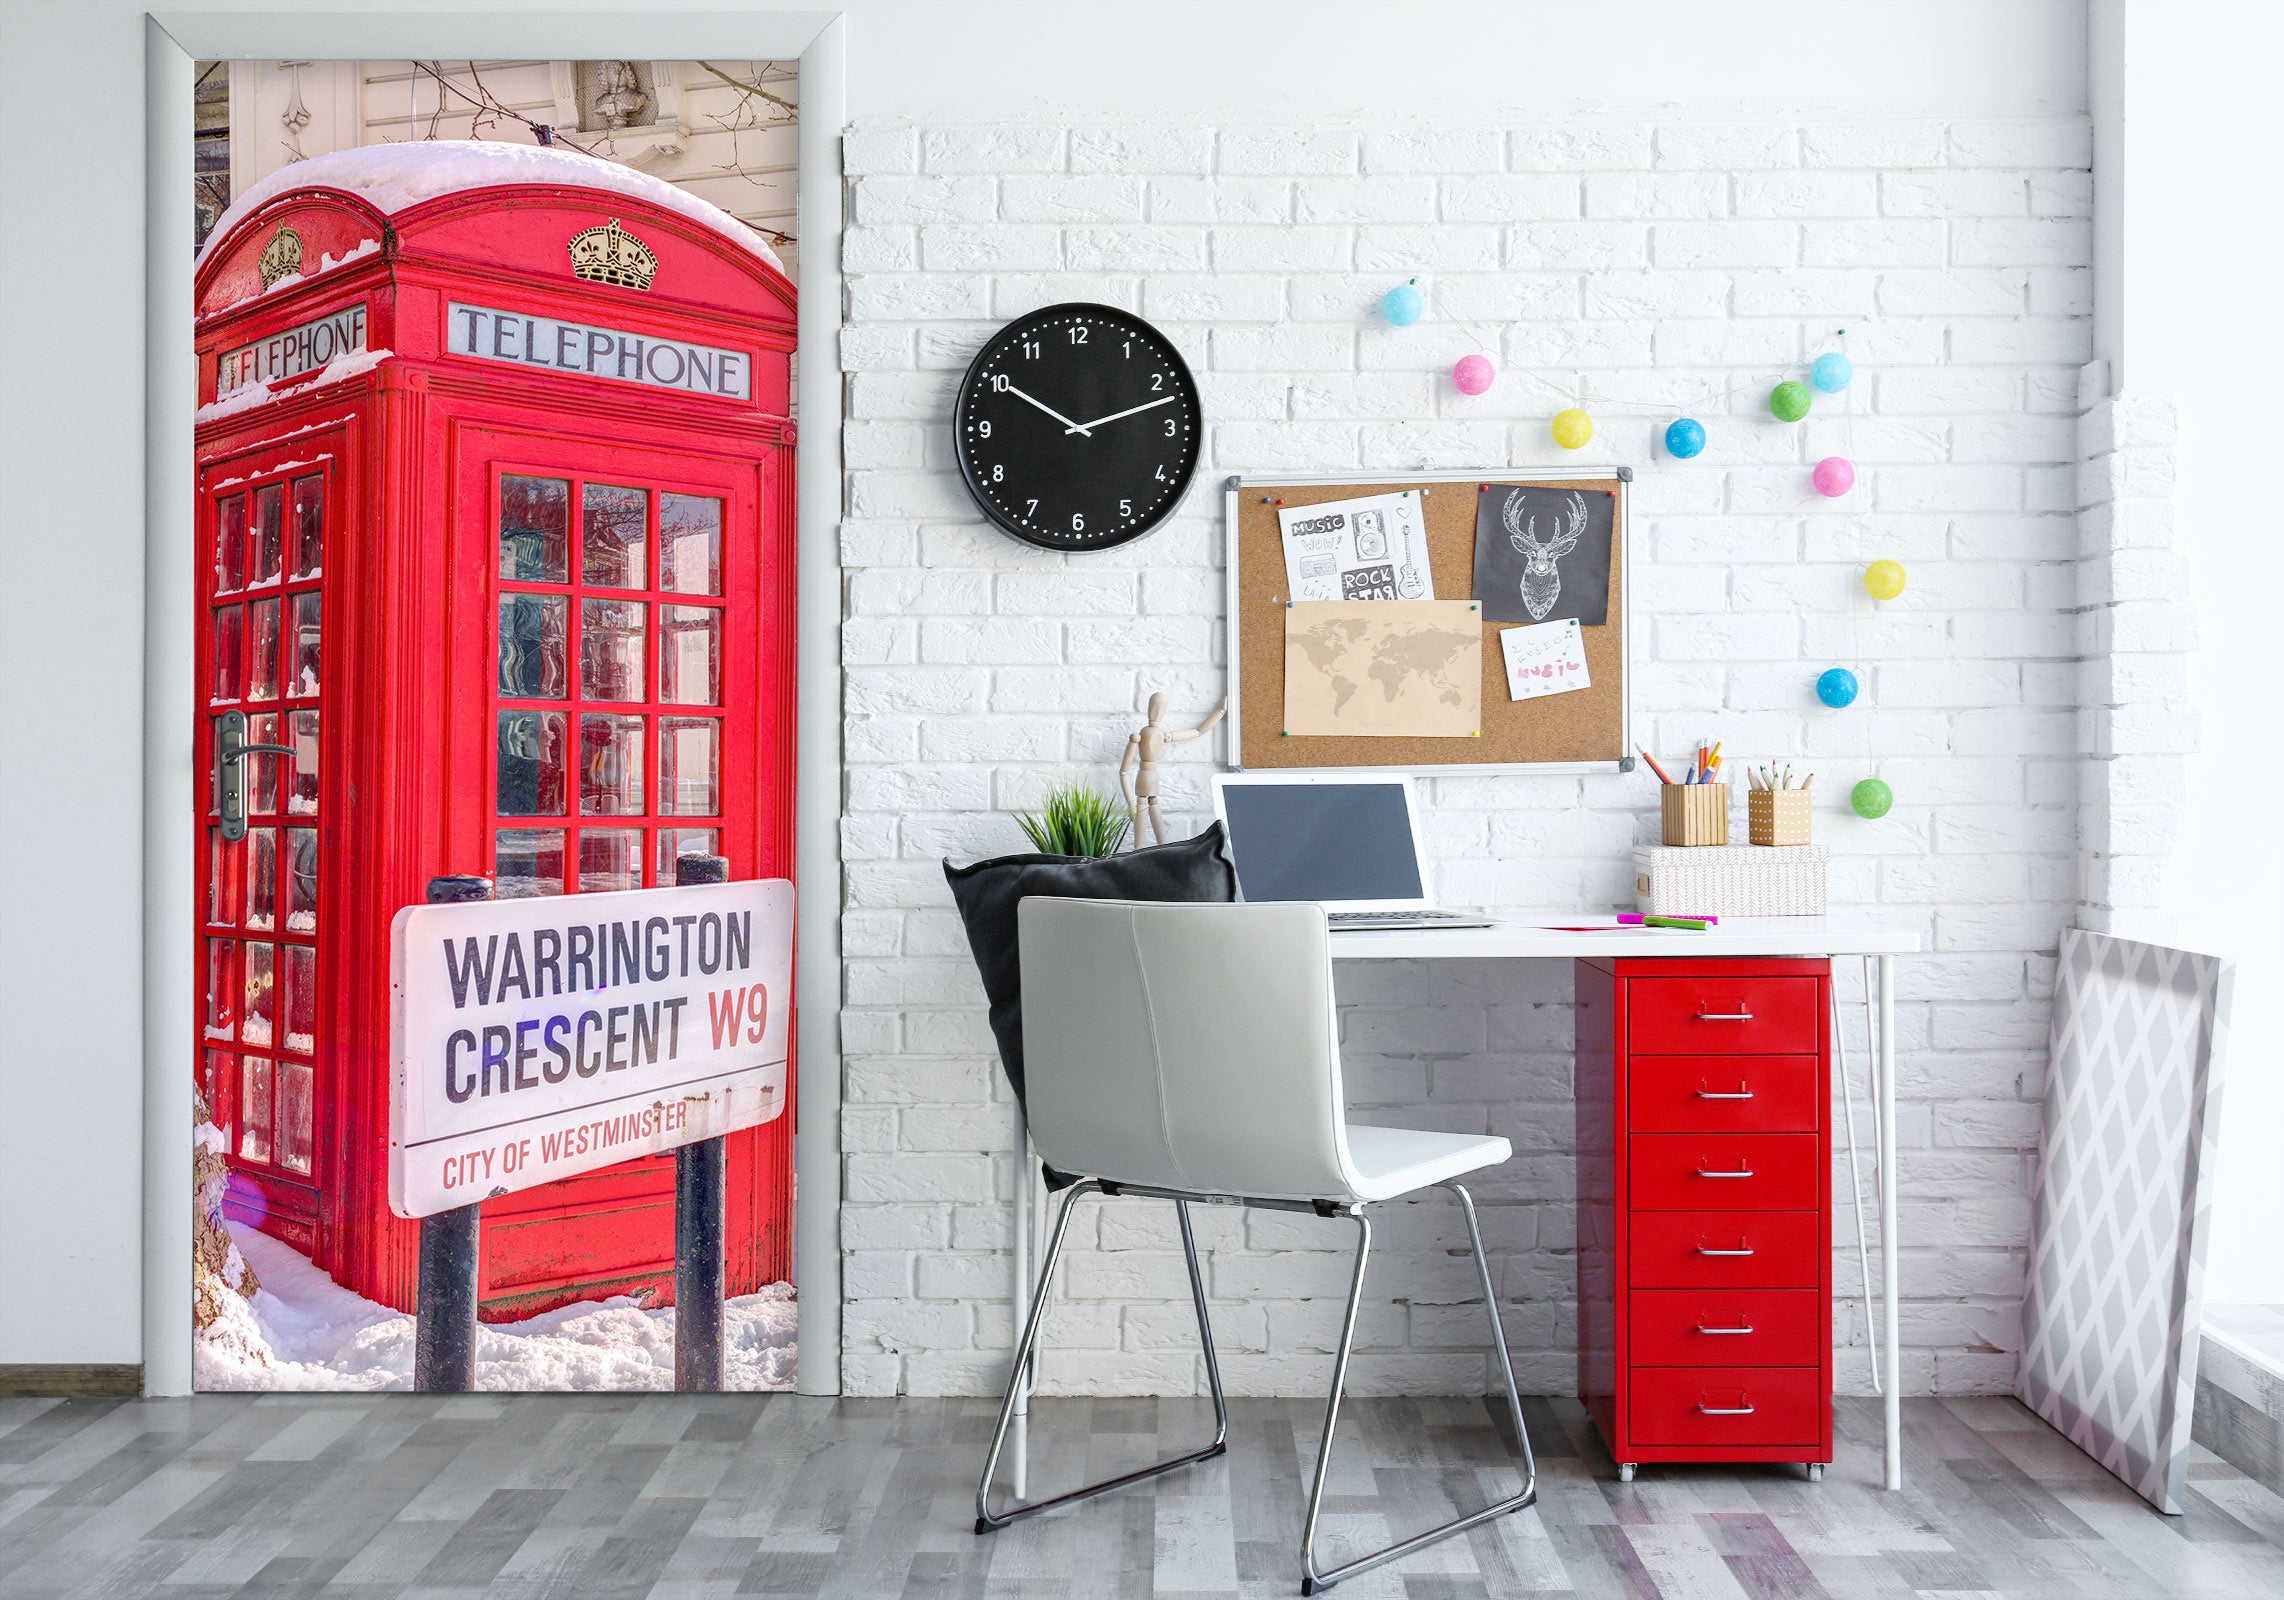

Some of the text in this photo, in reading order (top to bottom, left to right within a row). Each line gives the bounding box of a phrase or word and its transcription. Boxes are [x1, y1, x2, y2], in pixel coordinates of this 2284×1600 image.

[1068, 327, 1088, 344] 12
[458, 308, 740, 396] TELEPHONE
[1023, 343, 1040, 359] 11
[1123, 343, 1129, 359] 1
[990, 375, 1009, 392] 10
[1151, 374, 1163, 391] 2
[979, 421, 991, 438] 9
[1165, 420, 1176, 437] 3
[993, 465, 1003, 482] 8
[1155, 465, 1166, 481] 4
[1027, 499, 1038, 516] 7
[1120, 500, 1131, 516] 5
[1073, 514, 1084, 530] 6
[1302, 535, 1343, 551] WOW!
[1344, 568, 1392, 588] ROCK
[443, 910, 751, 1010] WARRINGTON
[444, 983, 768, 1104] CRESCENT W9
[442, 1101, 688, 1190] CITY OF WESTMINSTER
